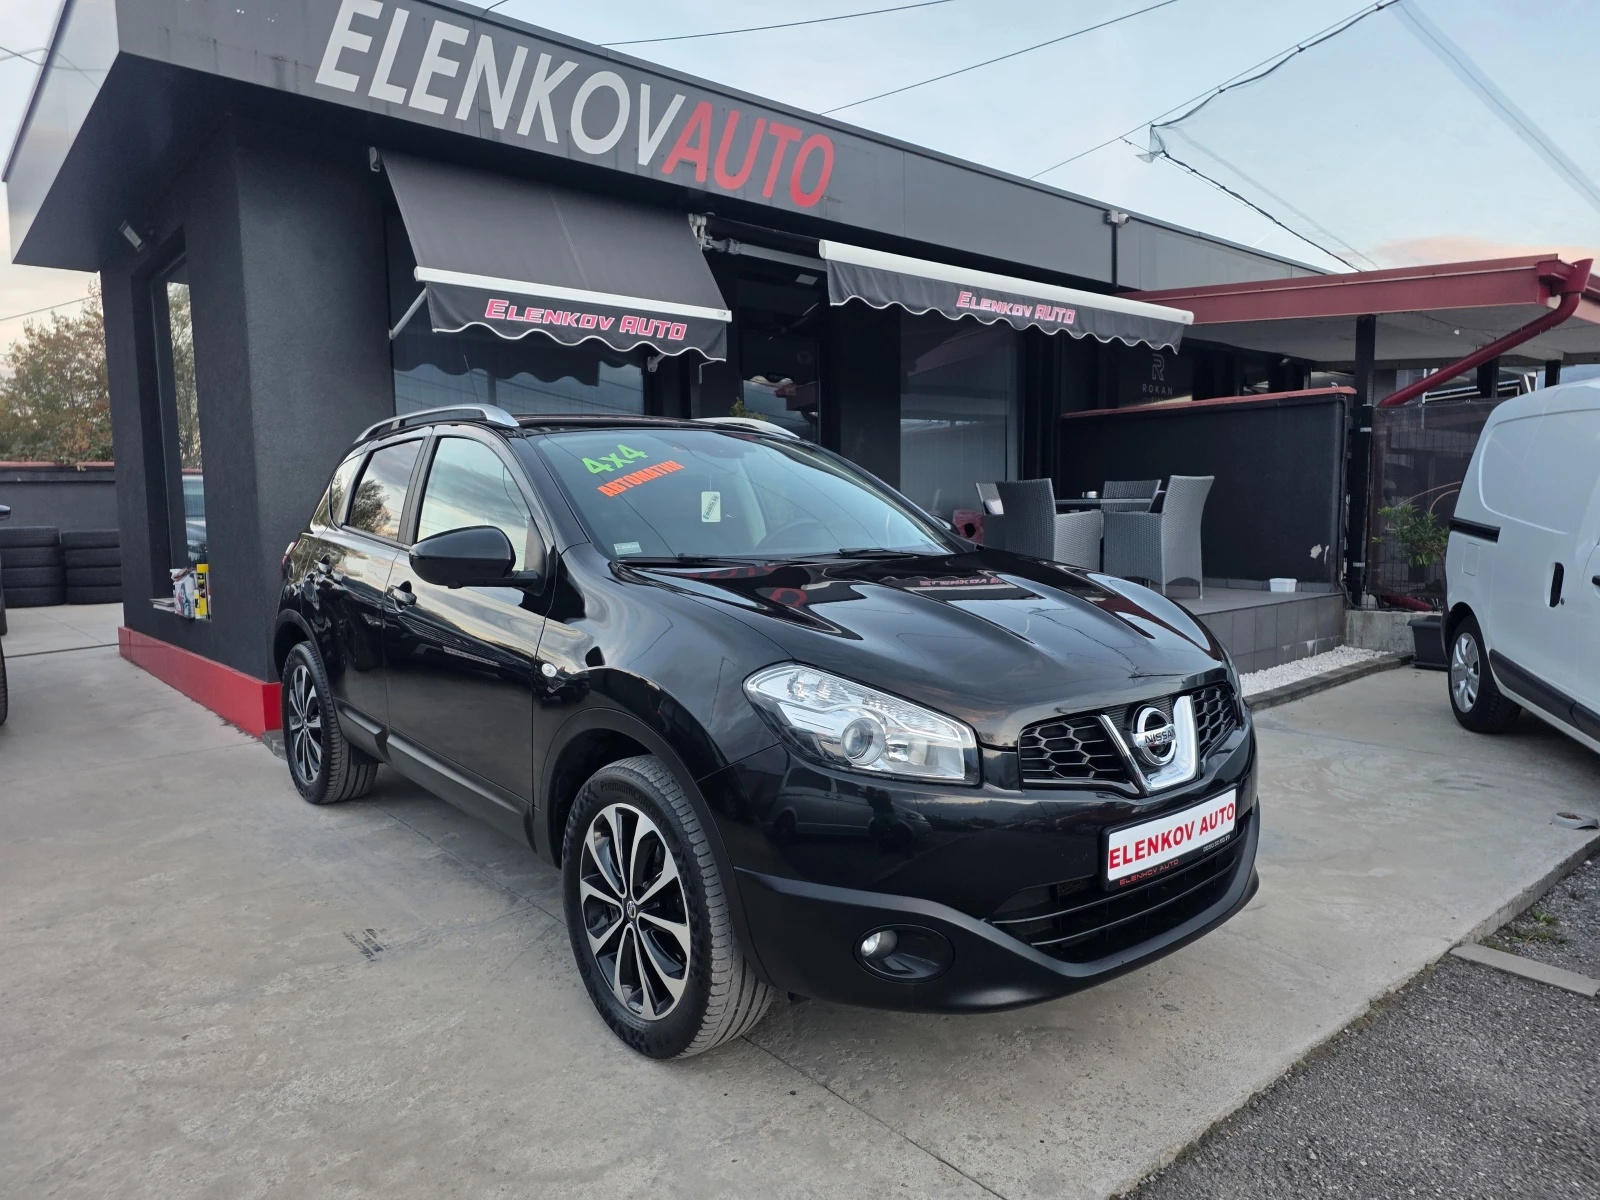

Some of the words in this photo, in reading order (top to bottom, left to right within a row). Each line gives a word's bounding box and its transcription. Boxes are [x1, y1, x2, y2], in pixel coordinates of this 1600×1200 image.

[484, 298, 615, 331] ELENKOV
[619, 315, 687, 341] AUTO
[956, 291, 1033, 318] ELENKOV
[1034, 304, 1076, 324] AUTO
[1142, 383, 1173, 396] ROKAN
[1144, 729, 1175, 743] NISSAN
[1108, 820, 1195, 869] ELENKOV
[1199, 802, 1235, 836] AUTO
